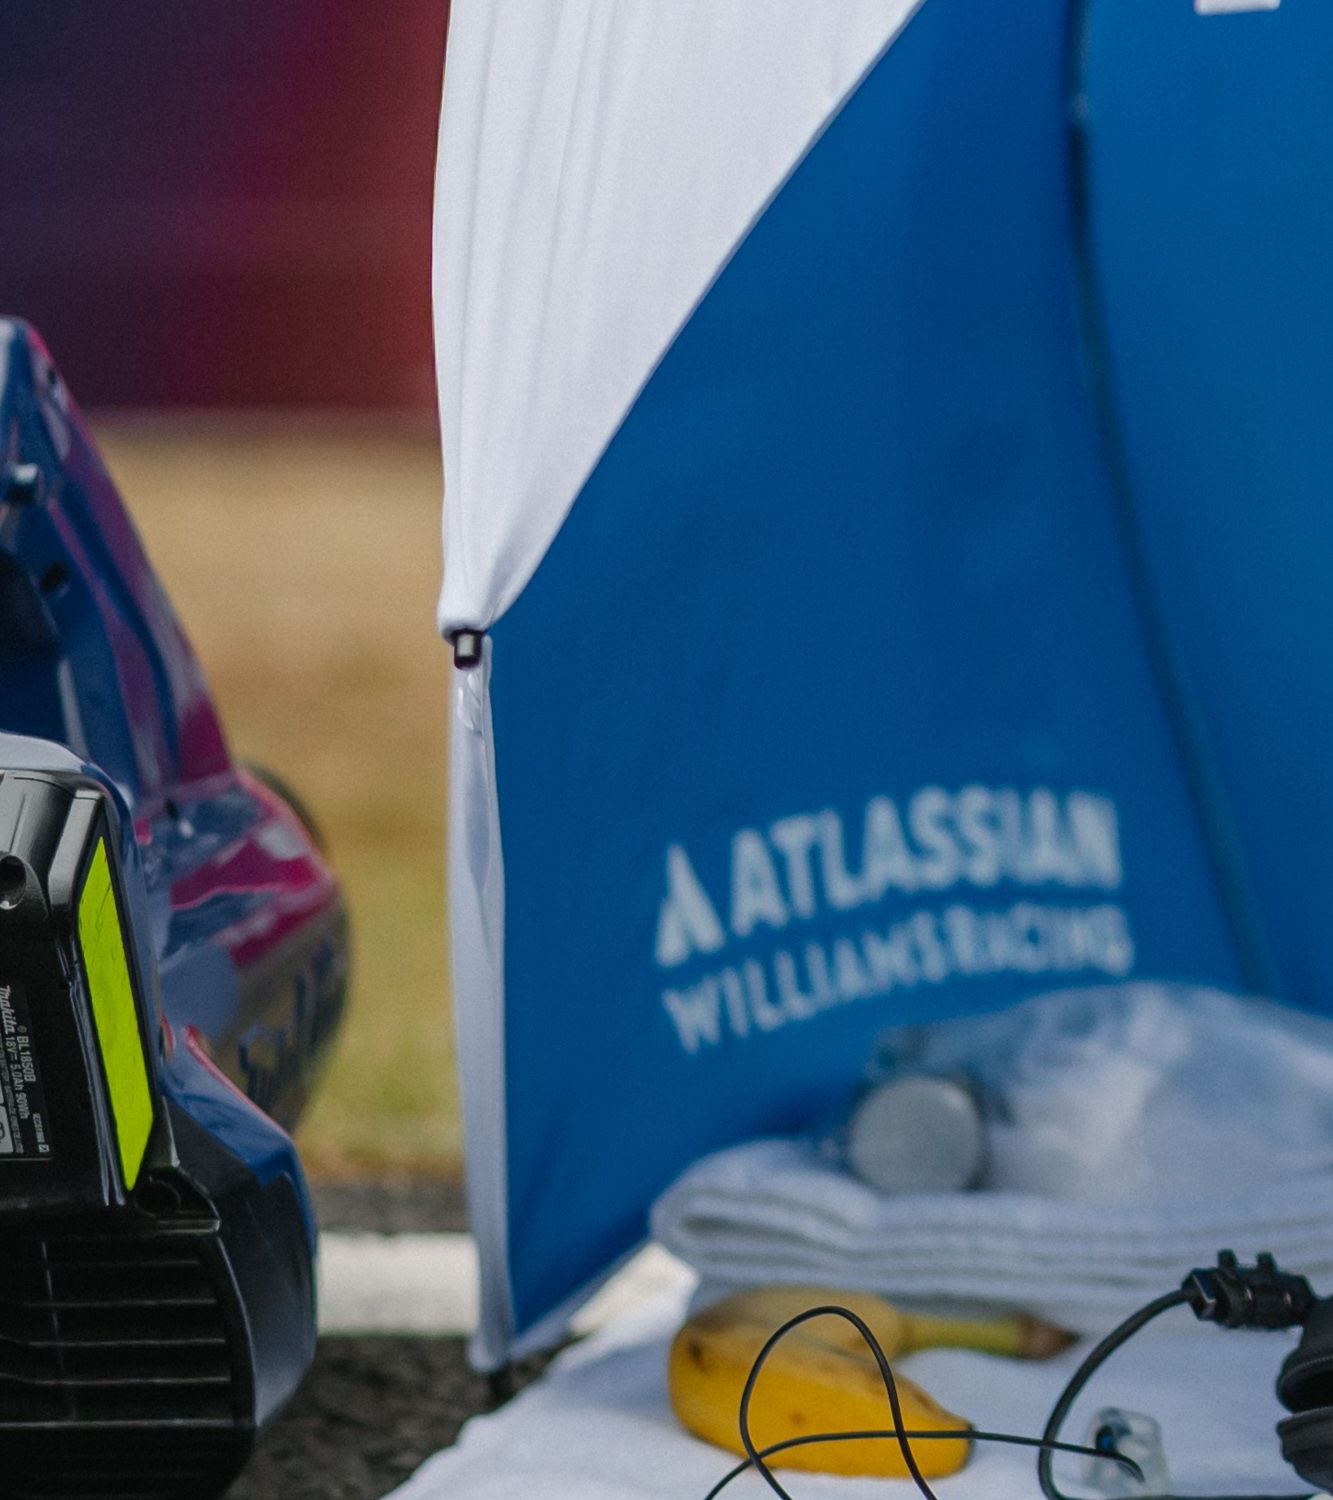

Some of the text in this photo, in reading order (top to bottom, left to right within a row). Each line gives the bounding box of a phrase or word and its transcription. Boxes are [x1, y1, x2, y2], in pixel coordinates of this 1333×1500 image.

[732, 784, 1122, 938] ATLASSIAN
[662, 911, 946, 1055] WILLIAMS
[15, 1092, 31, 1120] 90Wh
[17, 1035, 37, 1083] BL1850B
